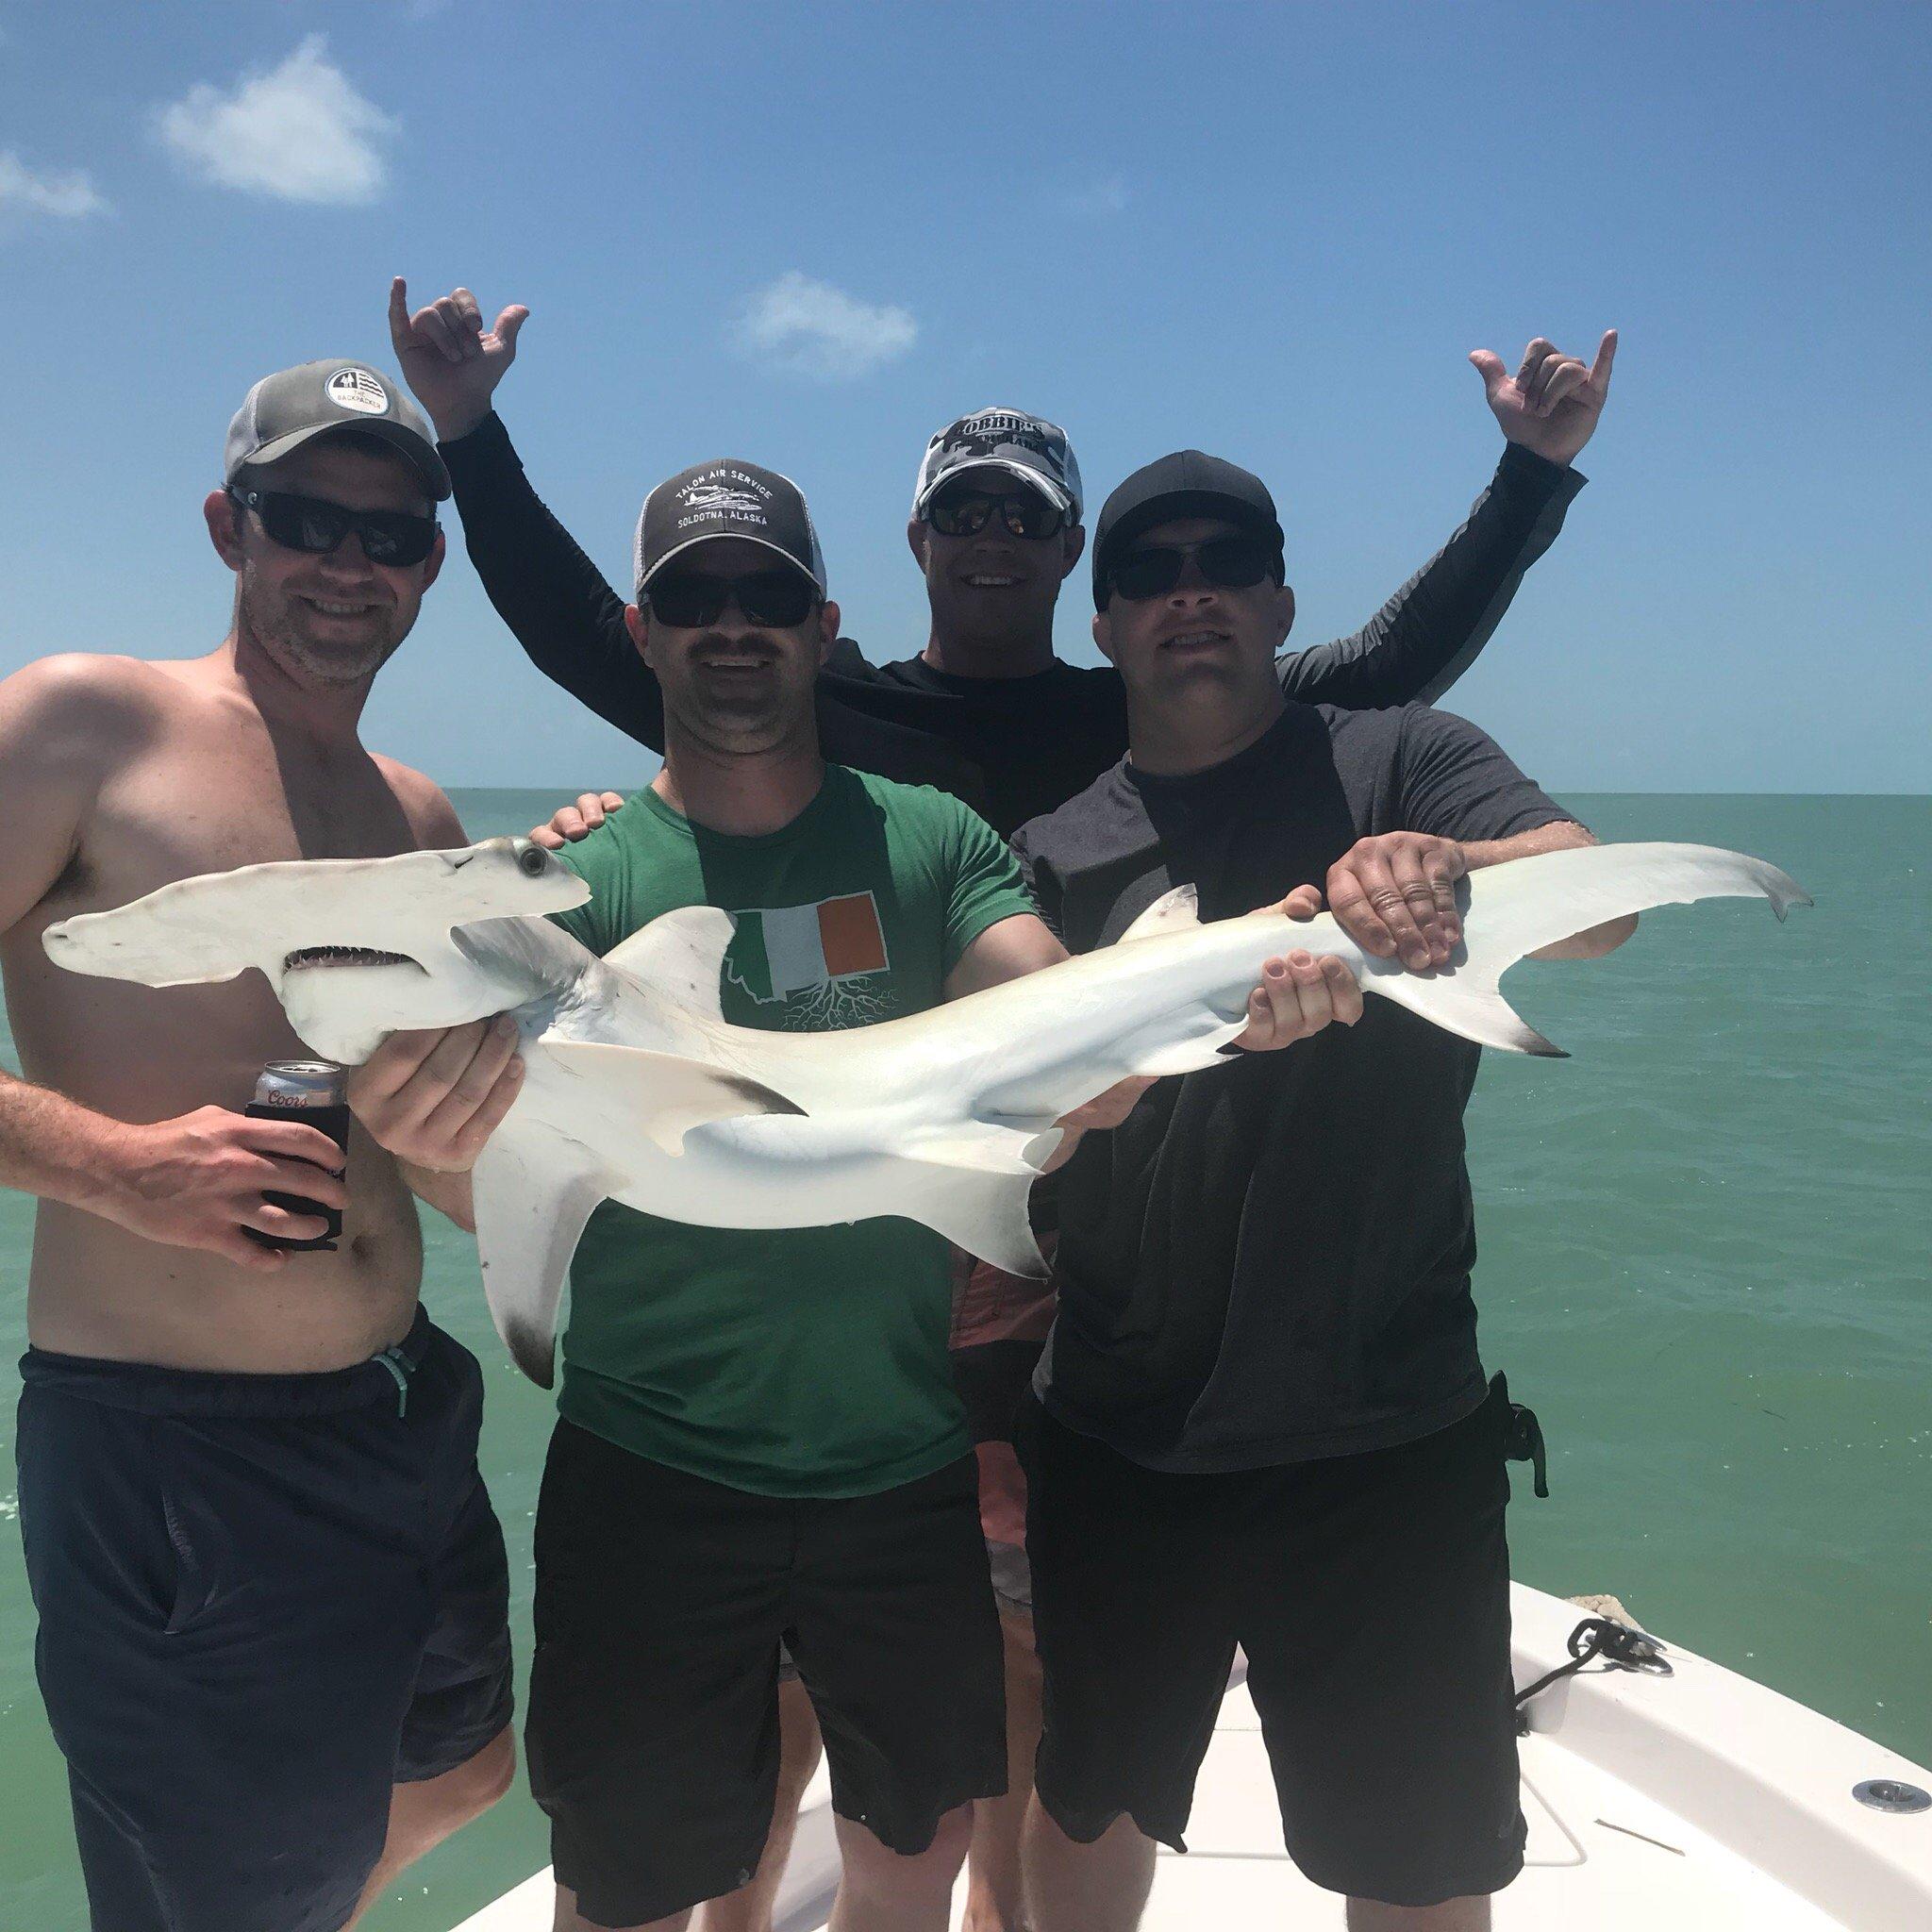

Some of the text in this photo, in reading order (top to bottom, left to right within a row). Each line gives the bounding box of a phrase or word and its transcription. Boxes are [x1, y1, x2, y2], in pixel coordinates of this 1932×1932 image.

[337, 394, 382, 409] BACKPACKER
[675, 469, 774, 500] TALON AIR SERVICE
[729, 510, 768, 525] ALASKA
[267, 1090, 309, 1108] Coors
